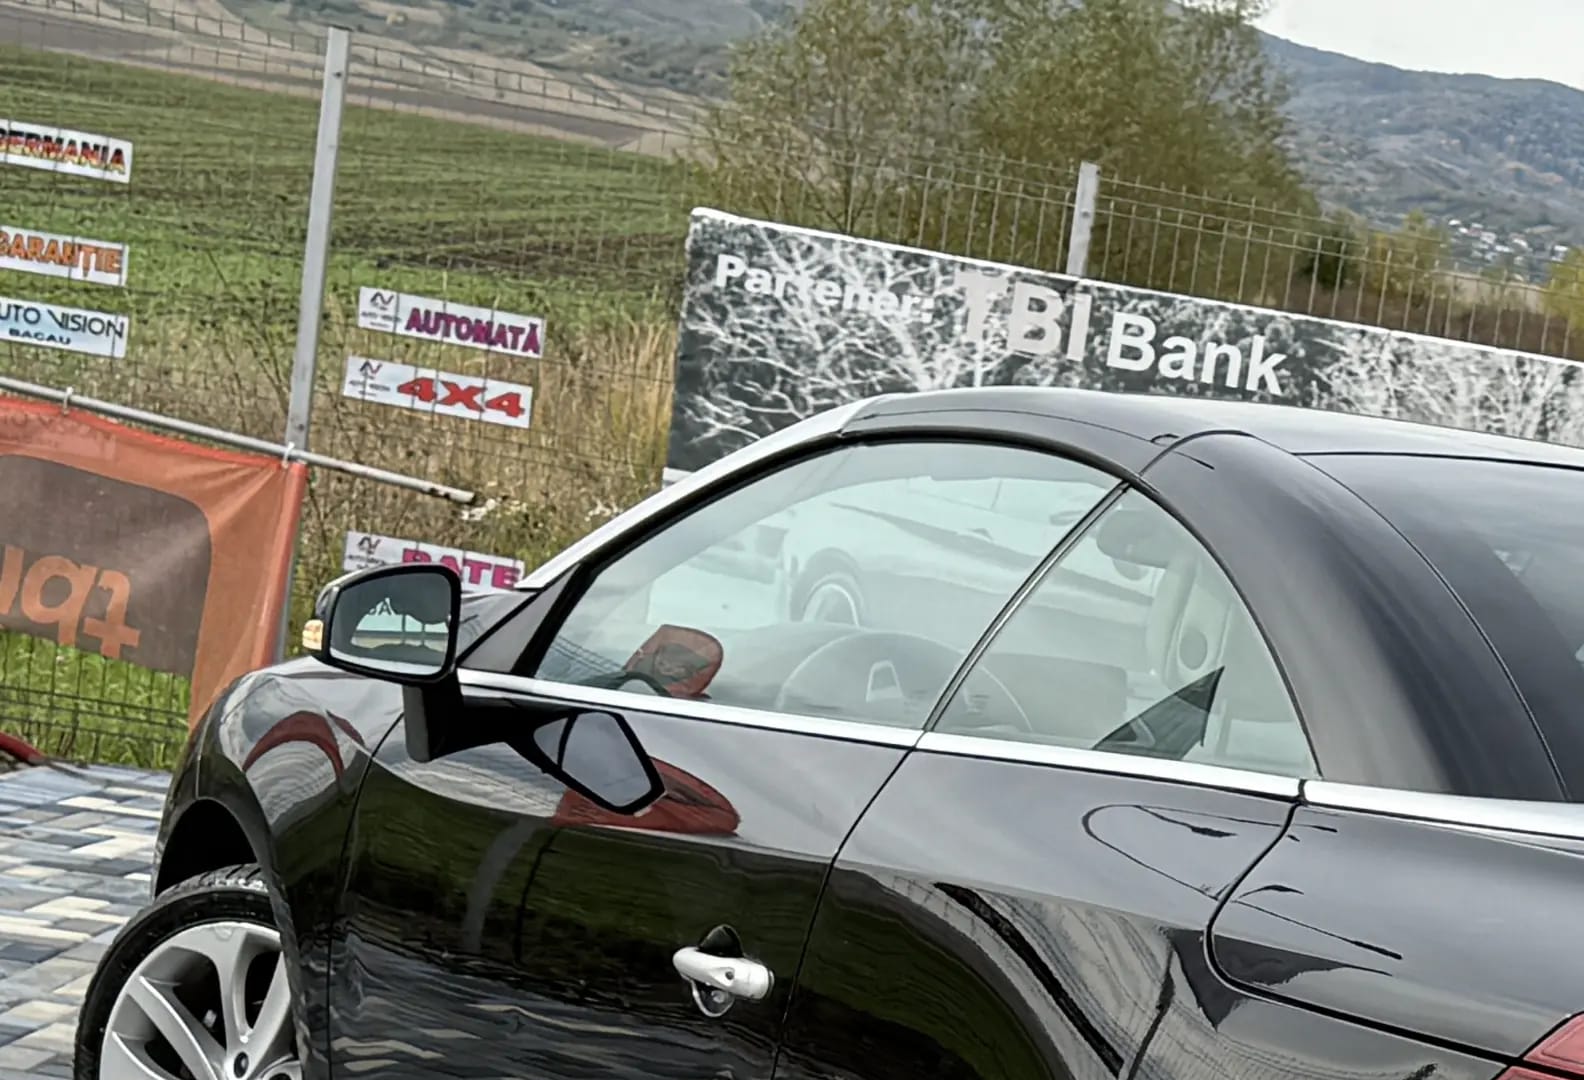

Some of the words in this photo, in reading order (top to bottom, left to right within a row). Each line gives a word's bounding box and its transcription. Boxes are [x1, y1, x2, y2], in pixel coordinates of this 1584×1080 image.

[0, 301, 41, 325] UTO
[46, 308, 125, 339] VISION
[9, 327, 72, 345] BACAU
[953, 268, 1092, 362] TBI
[1106, 311, 1287, 396] Bank
